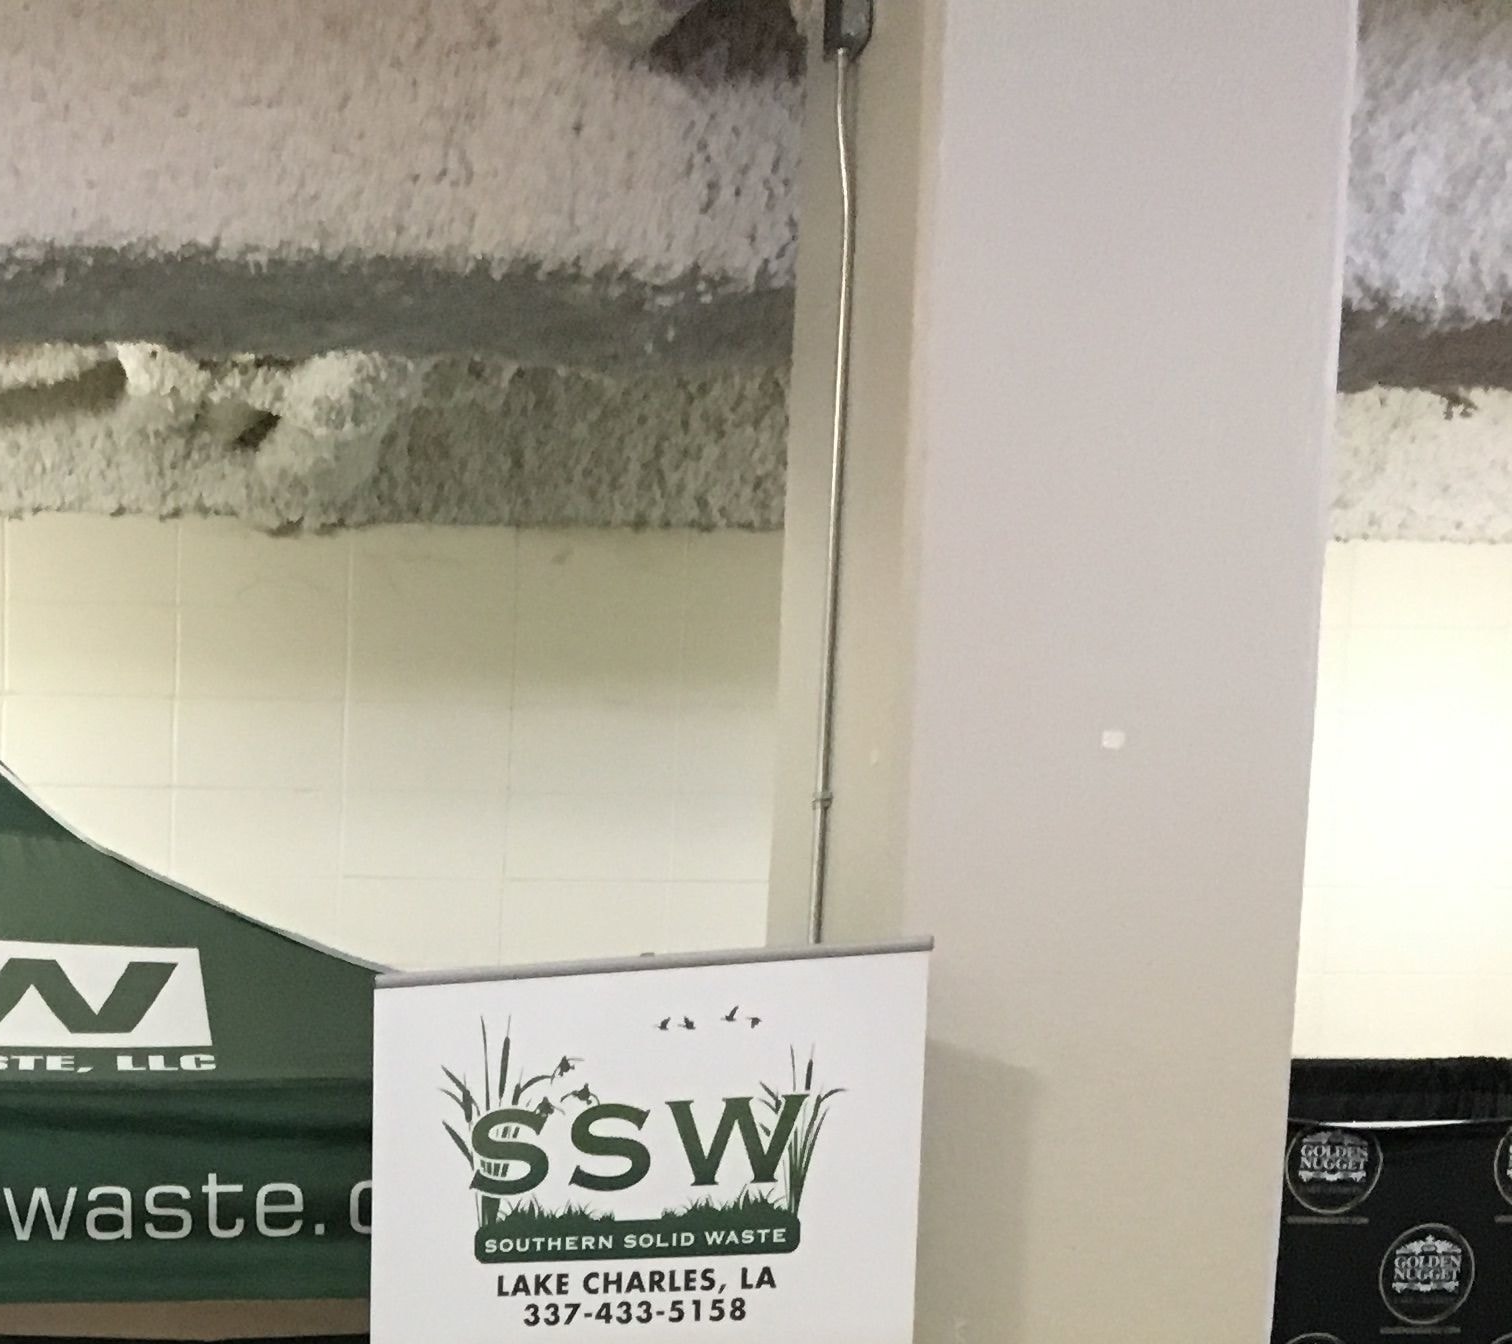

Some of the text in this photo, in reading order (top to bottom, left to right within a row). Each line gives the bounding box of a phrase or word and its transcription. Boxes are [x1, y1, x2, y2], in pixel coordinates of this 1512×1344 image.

[116, 1053, 216, 1072] LLC
[469, 1093, 810, 1196] SSW
[484, 1228, 787, 1254] SOUTHERN SOLID WASTE
[1394, 1255, 1462, 1270] GOLDEN
[1394, 1268, 1457, 1280] NUGGET
[497, 1266, 777, 1297] LAKE CHARLES, LA
[523, 1298, 747, 1327] 337-433-5158
